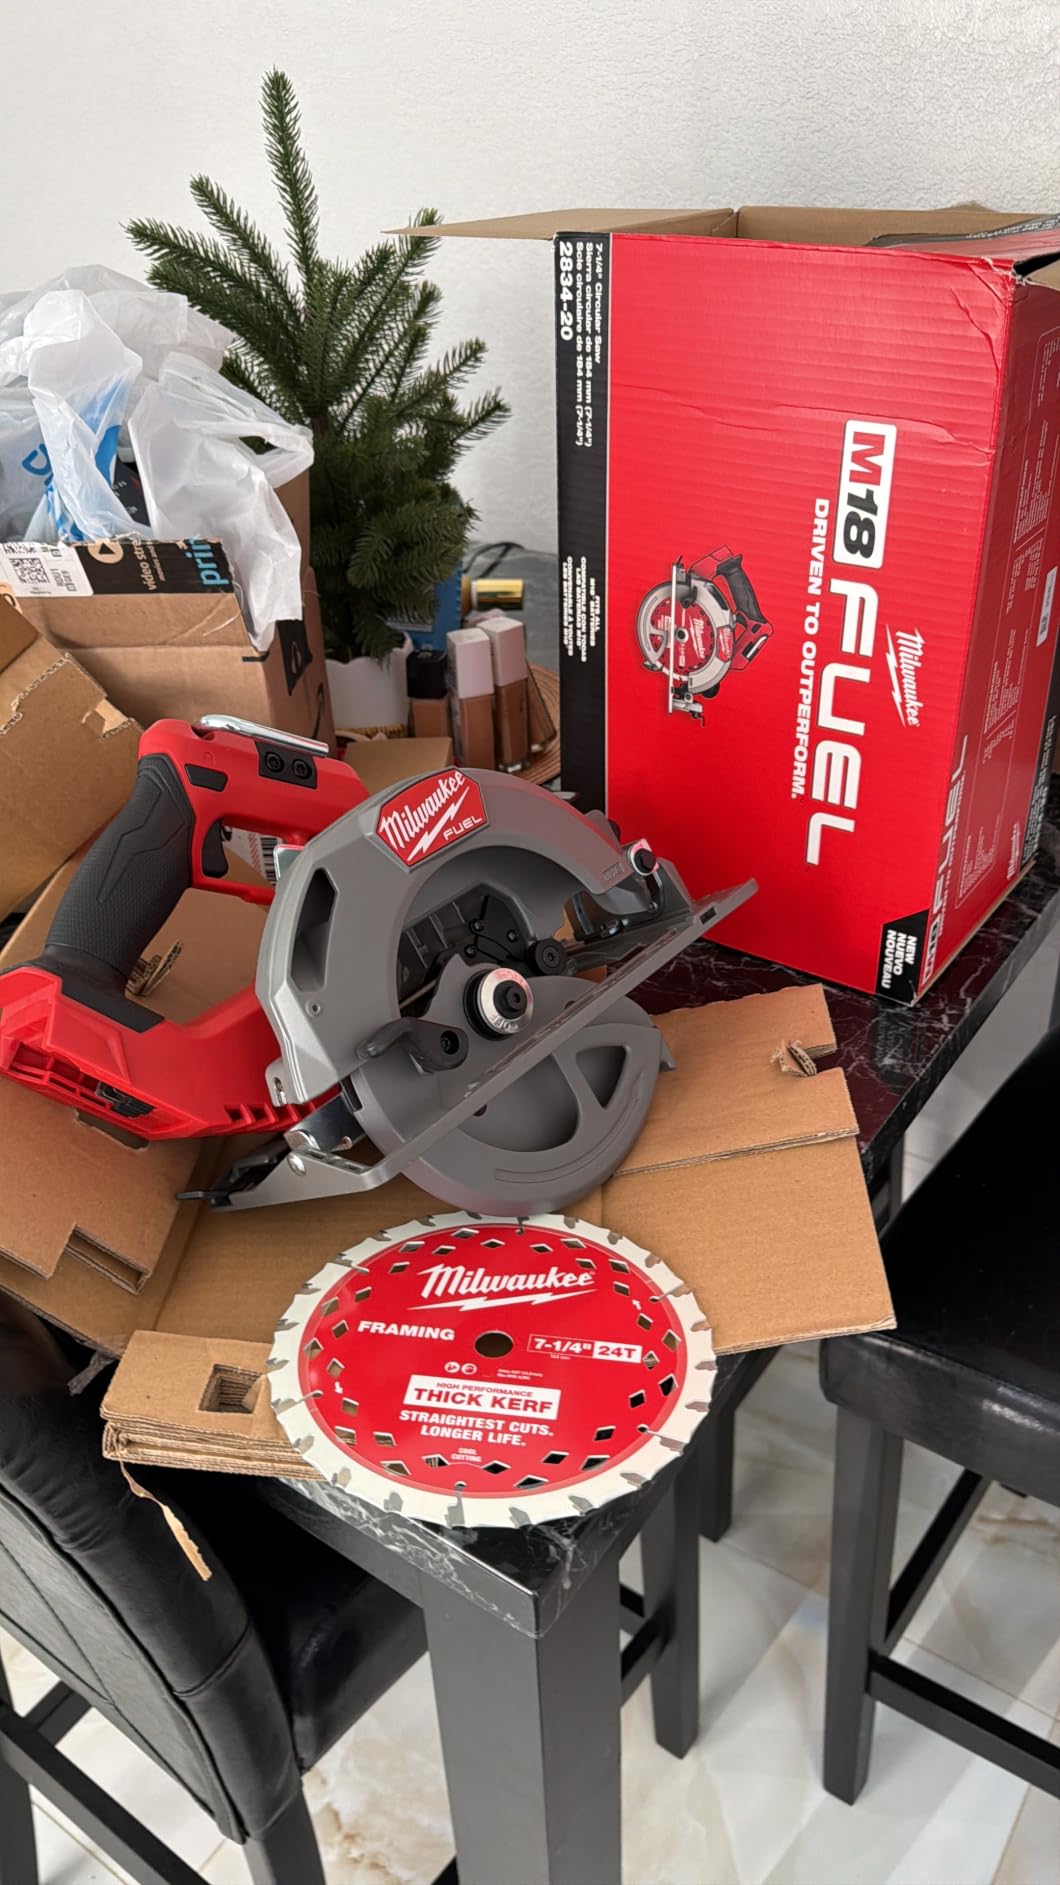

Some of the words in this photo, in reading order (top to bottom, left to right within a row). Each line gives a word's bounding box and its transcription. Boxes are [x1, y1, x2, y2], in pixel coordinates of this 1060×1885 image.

[576, 241, 584, 270] Scie
[585, 241, 594, 282] Sierra
[559, 240, 573, 341] 2834-20
[576, 273, 584, 333] circulaire
[594, 282, 603, 333] Circular
[585, 286, 593, 334] circular
[576, 335, 583, 351] de
[585, 336, 593, 352] de
[594, 335, 602, 363] Saw
[576, 379, 582, 402] mm
[585, 380, 592, 403] mm
[841, 430, 886, 560] M18
[807, 498, 830, 596] DRIVEN
[137, 561, 158, 591] video
[804, 602, 819, 634] TO
[896, 628, 924, 727] Milwaukee
[791, 641, 817, 799] OUTPERFORM.
[806, 578, 880, 866] FUEL
[380, 770, 465, 849] Milwaukee
[442, 814, 483, 842] FUEL
[881, 929, 896, 989] NOUVEAU
[893, 932, 907, 976] NUEVO
[905, 935, 918, 965] NEW
[418, 1263, 594, 1298] Milwaukee
[357, 1320, 455, 1342] FRAMING
[533, 1337, 592, 1355] 7-1/4"
[597, 1344, 638, 1360] 24T
[413, 1387, 485, 1407] THICK
[490, 1395, 554, 1415] KERF
[436, 1382, 460, 1390] HIGH
[462, 1383, 533, 1398] PERFORMANCE
[399, 1410, 506, 1431] STRAIGHTEST
[508, 1418, 554, 1437] CUTS.
[420, 1424, 484, 1442] LONGER
[486, 1431, 526, 1447] LIFE.
